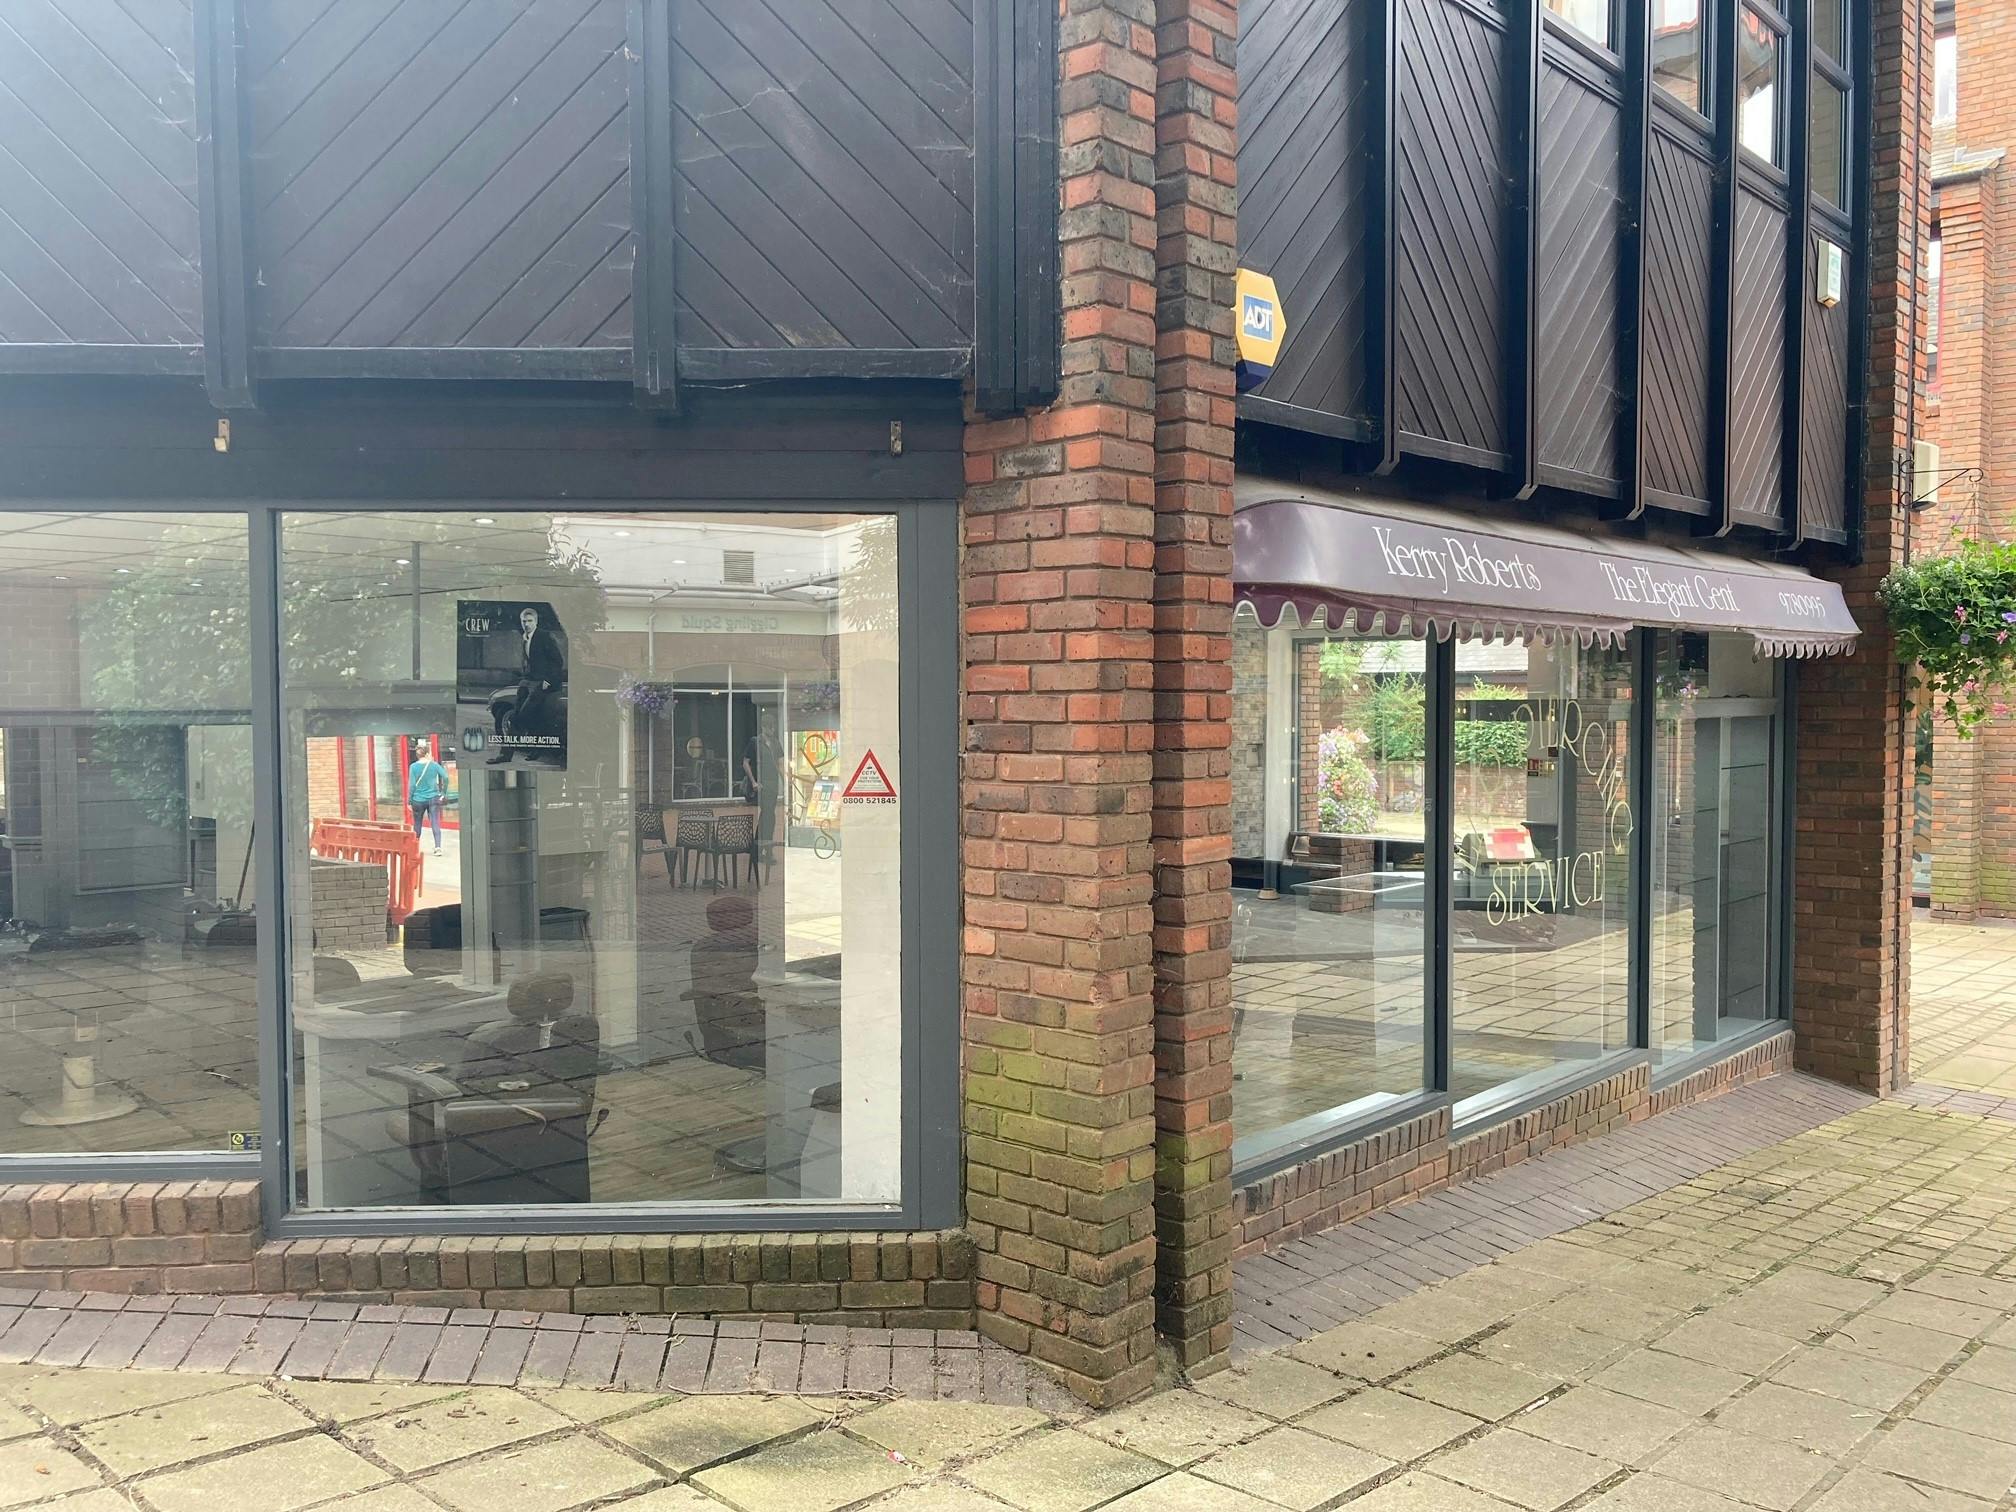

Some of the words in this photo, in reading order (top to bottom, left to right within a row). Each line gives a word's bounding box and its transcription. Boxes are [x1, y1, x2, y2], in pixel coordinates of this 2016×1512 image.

[1243, 303, 1273, 333] ADT
[1371, 526, 1448, 594] Kerry
[1442, 537, 1542, 592] Roberts
[1598, 559, 1641, 603] The
[1632, 566, 1700, 618] Elegant
[1694, 574, 1741, 612] Gent
[465, 617, 490, 632] CREW
[488, 735, 502, 743] LESS
[503, 735, 519, 744] TALK.
[520, 736, 537, 744] MORE
[537, 736, 561, 745] ACTION.
[1486, 850, 1605, 927] SERVICE
